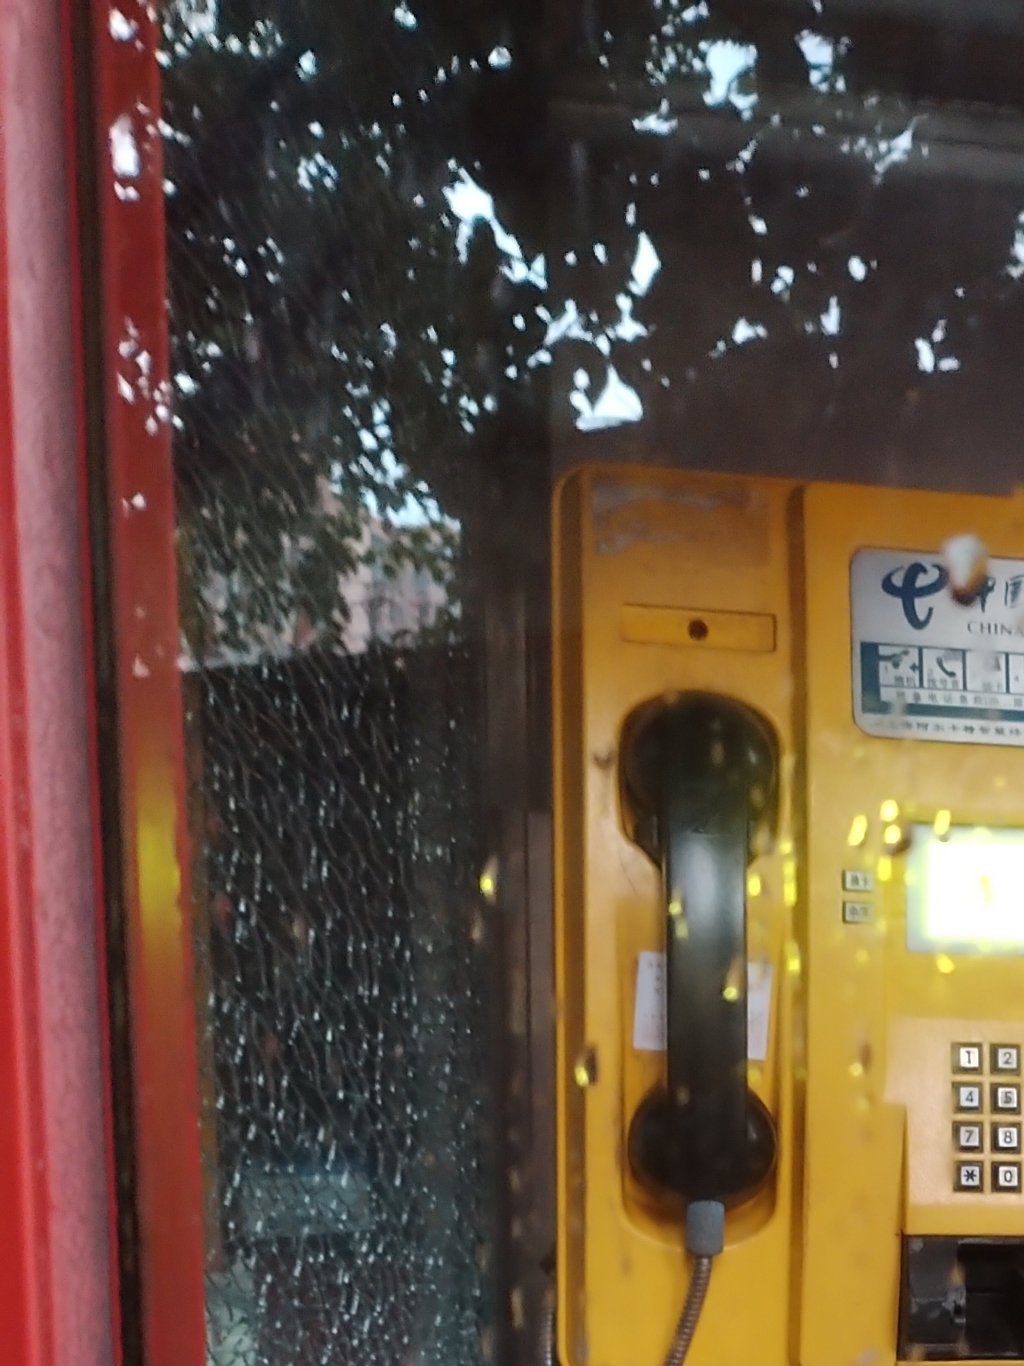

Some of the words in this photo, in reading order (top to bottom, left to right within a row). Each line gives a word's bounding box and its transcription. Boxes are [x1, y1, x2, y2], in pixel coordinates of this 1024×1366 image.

[965, 1051, 972, 1064] 1
[1003, 1052, 1012, 1065] 2
[965, 1091, 974, 1103] 4
[1003, 1091, 1013, 1104] 5
[965, 1130, 974, 1143] 7
[1003, 1131, 1012, 1144] 8
[1004, 1170, 1013, 1183] 0
